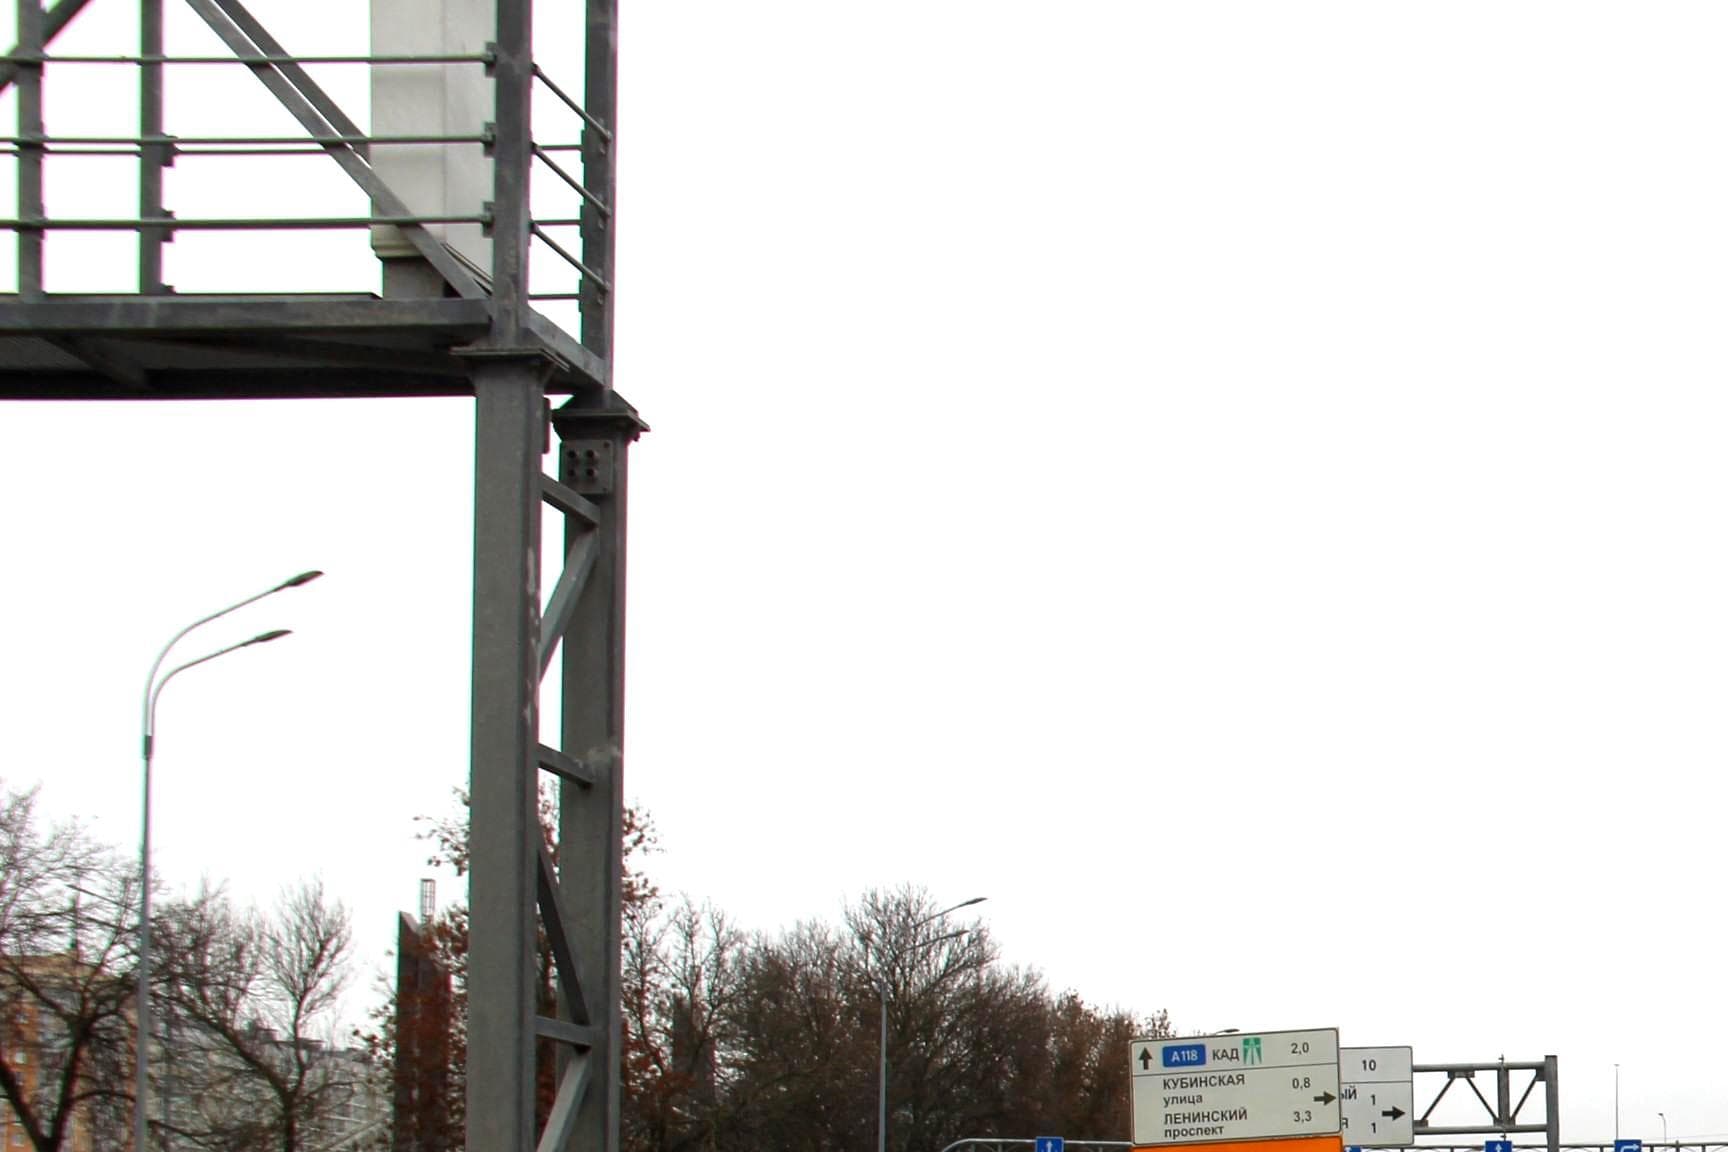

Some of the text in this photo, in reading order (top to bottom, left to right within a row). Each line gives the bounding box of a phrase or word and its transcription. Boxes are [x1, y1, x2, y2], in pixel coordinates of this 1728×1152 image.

[1212, 1042, 1310, 1062] КАД 2,0
[1362, 1059, 1377, 1071] 10
[1163, 1074, 1312, 1091] КУБИНСКАЯ 0,8
[1163, 1094, 1203, 1108] улица
[1371, 1093, 1376, 1106] 1
[1164, 1107, 1313, 1125] ЛЕНИНСКИЙ 3,3
[1164, 1125, 1225, 1140] проспект
[1371, 1121, 1377, 1134] 1
